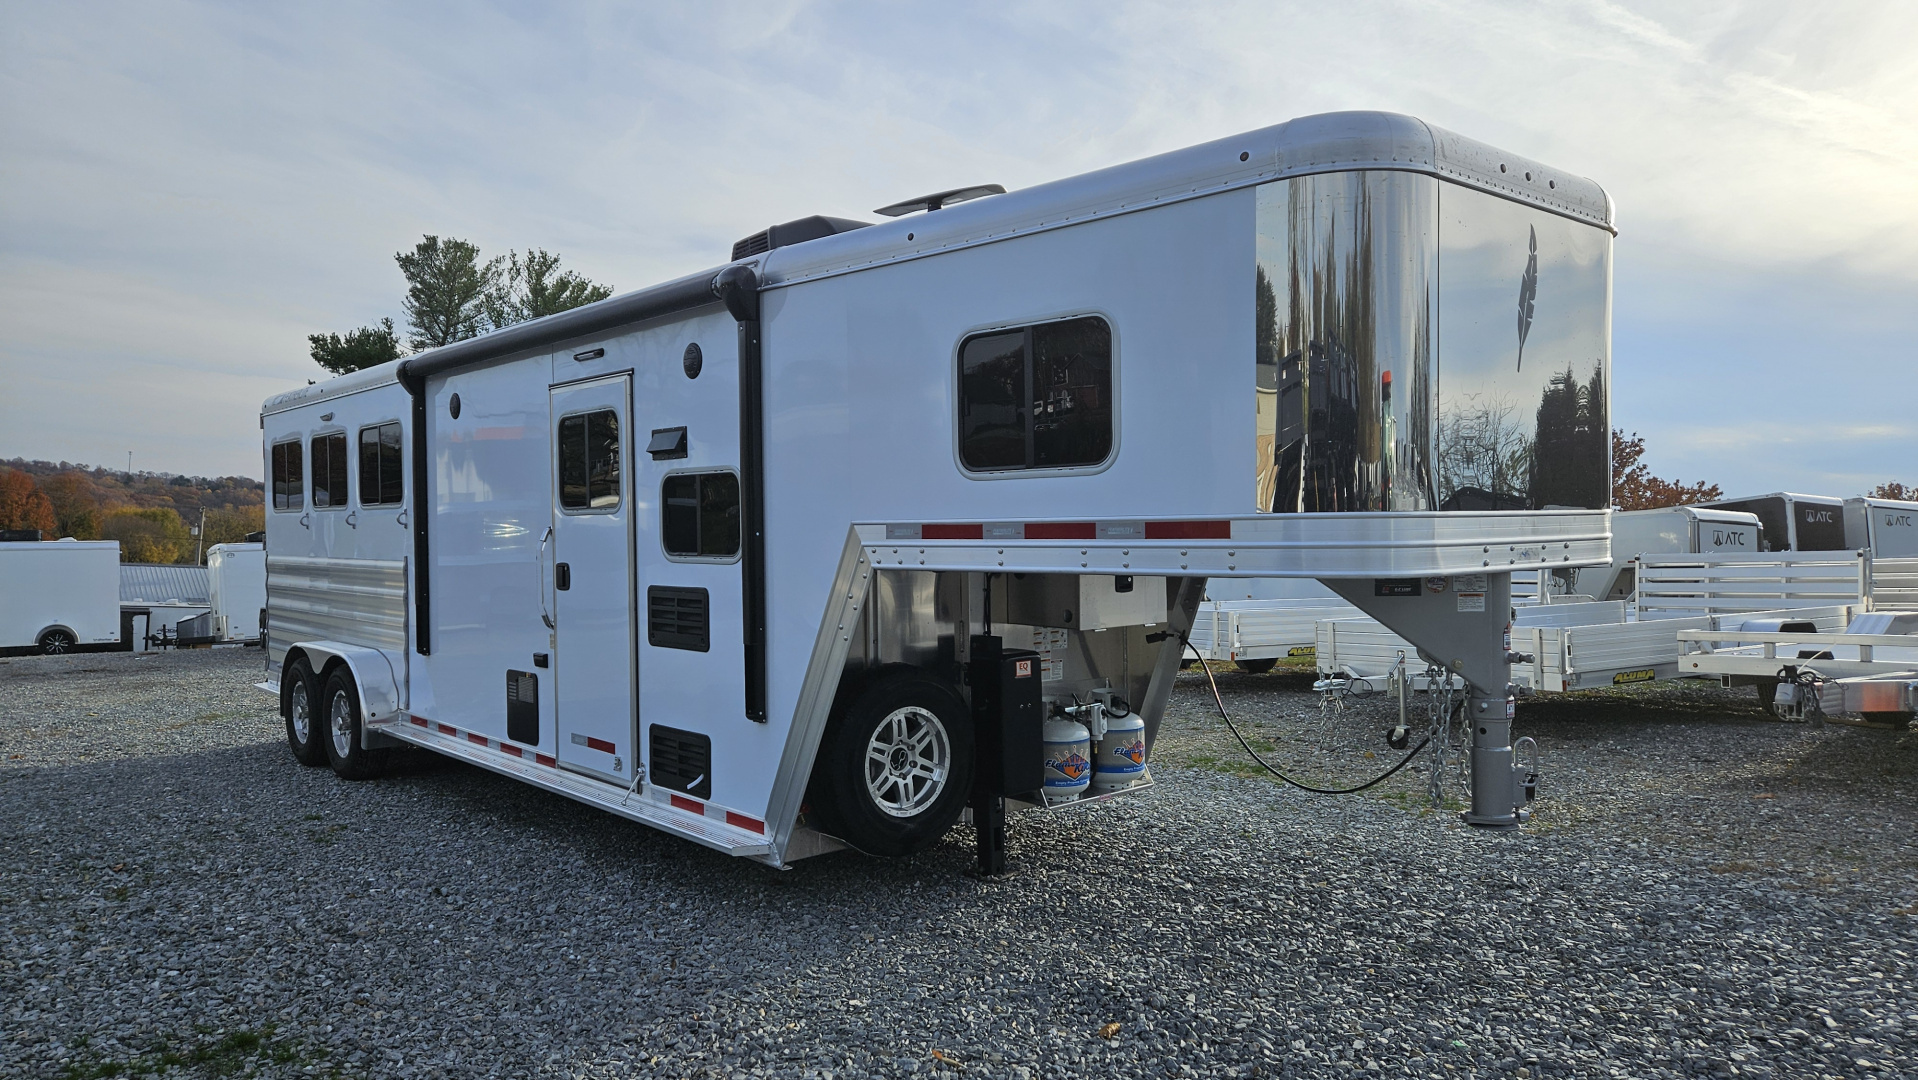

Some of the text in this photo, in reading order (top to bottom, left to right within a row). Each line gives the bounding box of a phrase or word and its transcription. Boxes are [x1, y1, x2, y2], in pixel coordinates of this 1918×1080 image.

[1816, 511, 1832, 522] ATC
[1895, 515, 1911, 526] ATC
[1725, 531, 1744, 545] ATC
[1019, 662, 1028, 671] EQ
[1613, 669, 1654, 682] ALUMA
